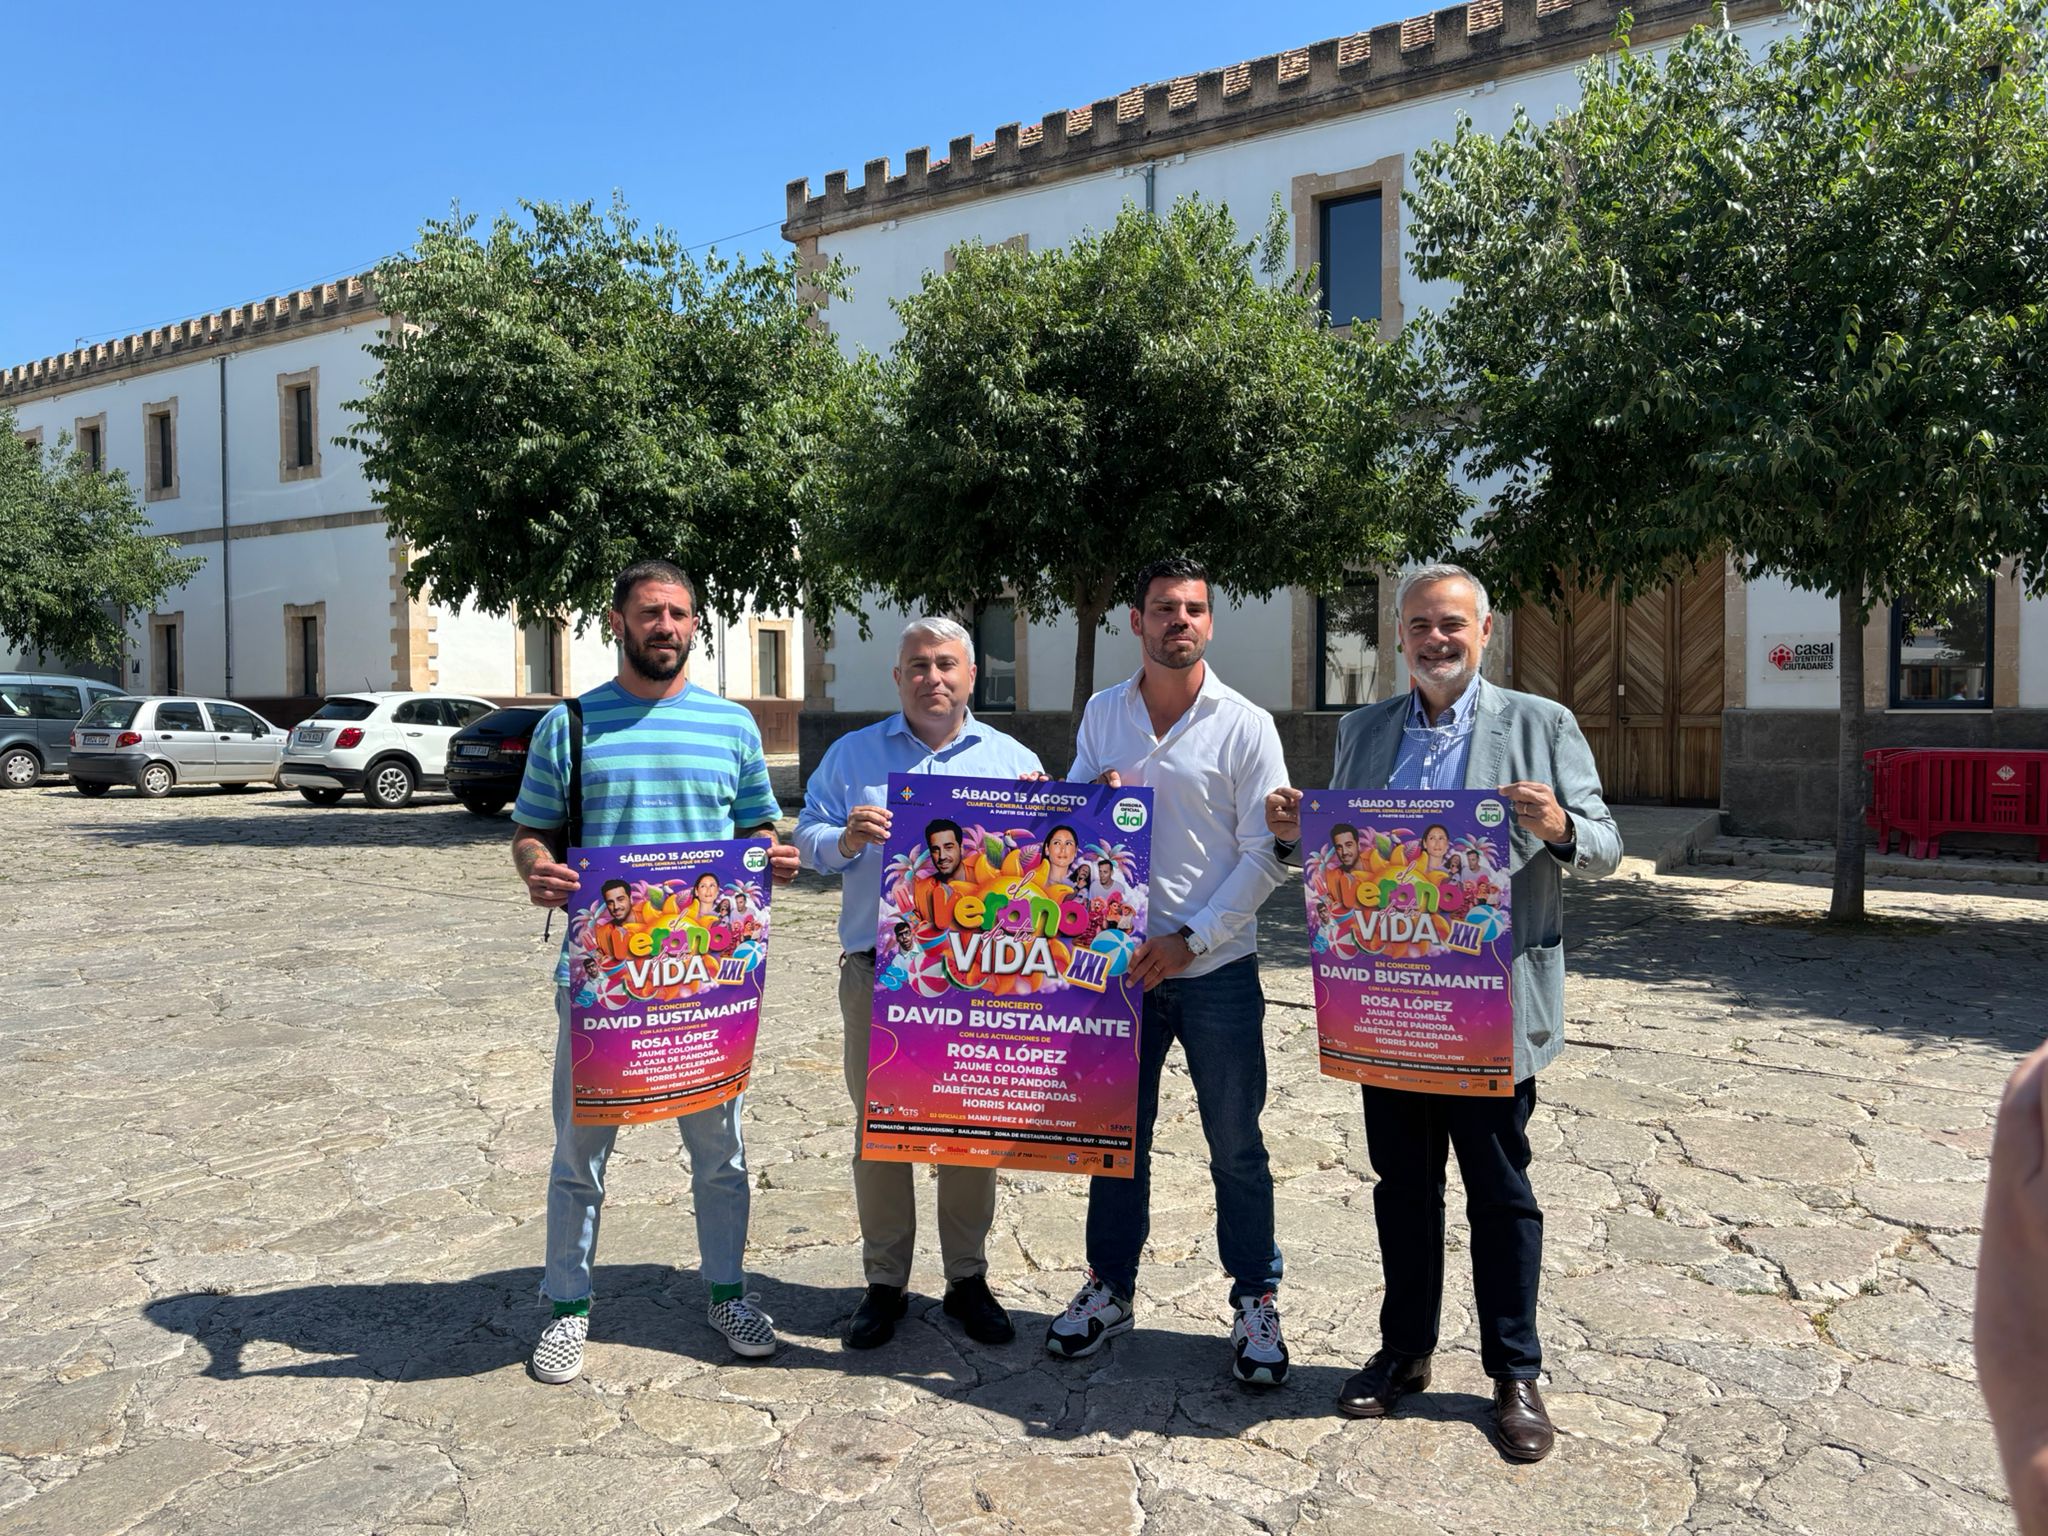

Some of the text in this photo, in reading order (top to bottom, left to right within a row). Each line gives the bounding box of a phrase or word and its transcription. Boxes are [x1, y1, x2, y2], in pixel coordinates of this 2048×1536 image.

[1795, 643, 1833, 655] casal
[1784, 662, 1833, 670] CIUTADANES
[952, 786, 1087, 806] SÁBADO 15 AGOSTO
[1348, 798, 1454, 808] SÁBADO 15 AGOSTO
[620, 850, 724, 864] SÁBADO 15 AGOSTO
[1006, 871, 1036, 899] el
[981, 918, 1036, 952] de tu
[1355, 910, 1440, 944] VIDA
[1450, 922, 1481, 950] XXL
[949, 932, 1057, 977] VIDA
[626, 956, 711, 988] VIDA
[717, 959, 745, 980] XXL
[1067, 949, 1110, 986] XXL
[1387, 962, 1431, 971] CONCIERTO
[1320, 964, 1504, 990] DAVID BUSTAMANTE
[659, 1002, 701, 1010] CONCIERTO
[971, 999, 1043, 1011] EN CONCIERTO
[1361, 994, 1453, 1012] ROSA LÓPEZ
[583, 997, 757, 1030] DAVID BUSTAMANTE
[1367, 1009, 1395, 1017] JAUME
[887, 1005, 1131, 1038] DAVID BUSTAMANTE
[1373, 1018, 1395, 1027] CAJA
[1410, 1021, 1455, 1032] PANDORA
[632, 1029, 719, 1049] ROSA LÓPEZ
[990, 1033, 1039, 1042] ACTUACIONES
[1354, 1025, 1463, 1041] DIABÉTICAS ACELERADAS
[1376, 1037, 1407, 1047] HORRIS
[637, 1049, 667, 1058] JAUME
[642, 1057, 665, 1066] CAJA
[681, 1049, 719, 1061] PANDORA
[947, 1043, 1067, 1065] ROSA LÓPEZ
[622, 1055, 725, 1076] DIABÉTICAS ACELERADAS
[954, 1061, 992, 1071] JAUME
[646, 1068, 705, 1082] HORRIS KAMOI
[943, 1073, 1067, 1089] LA CAJA DE PANDORA
[932, 1082, 1077, 1102] DIABÉTICAS ACELERADAS
[902, 1109, 918, 1117] GTS
[962, 1099, 1045, 1112] HORRIS KAMOI
[992, 1115, 1017, 1124] PÉREZ
[1025, 1119, 1054, 1127] MIQUEL
[1020, 1132, 1062, 1140] RESTAURACIÓN
